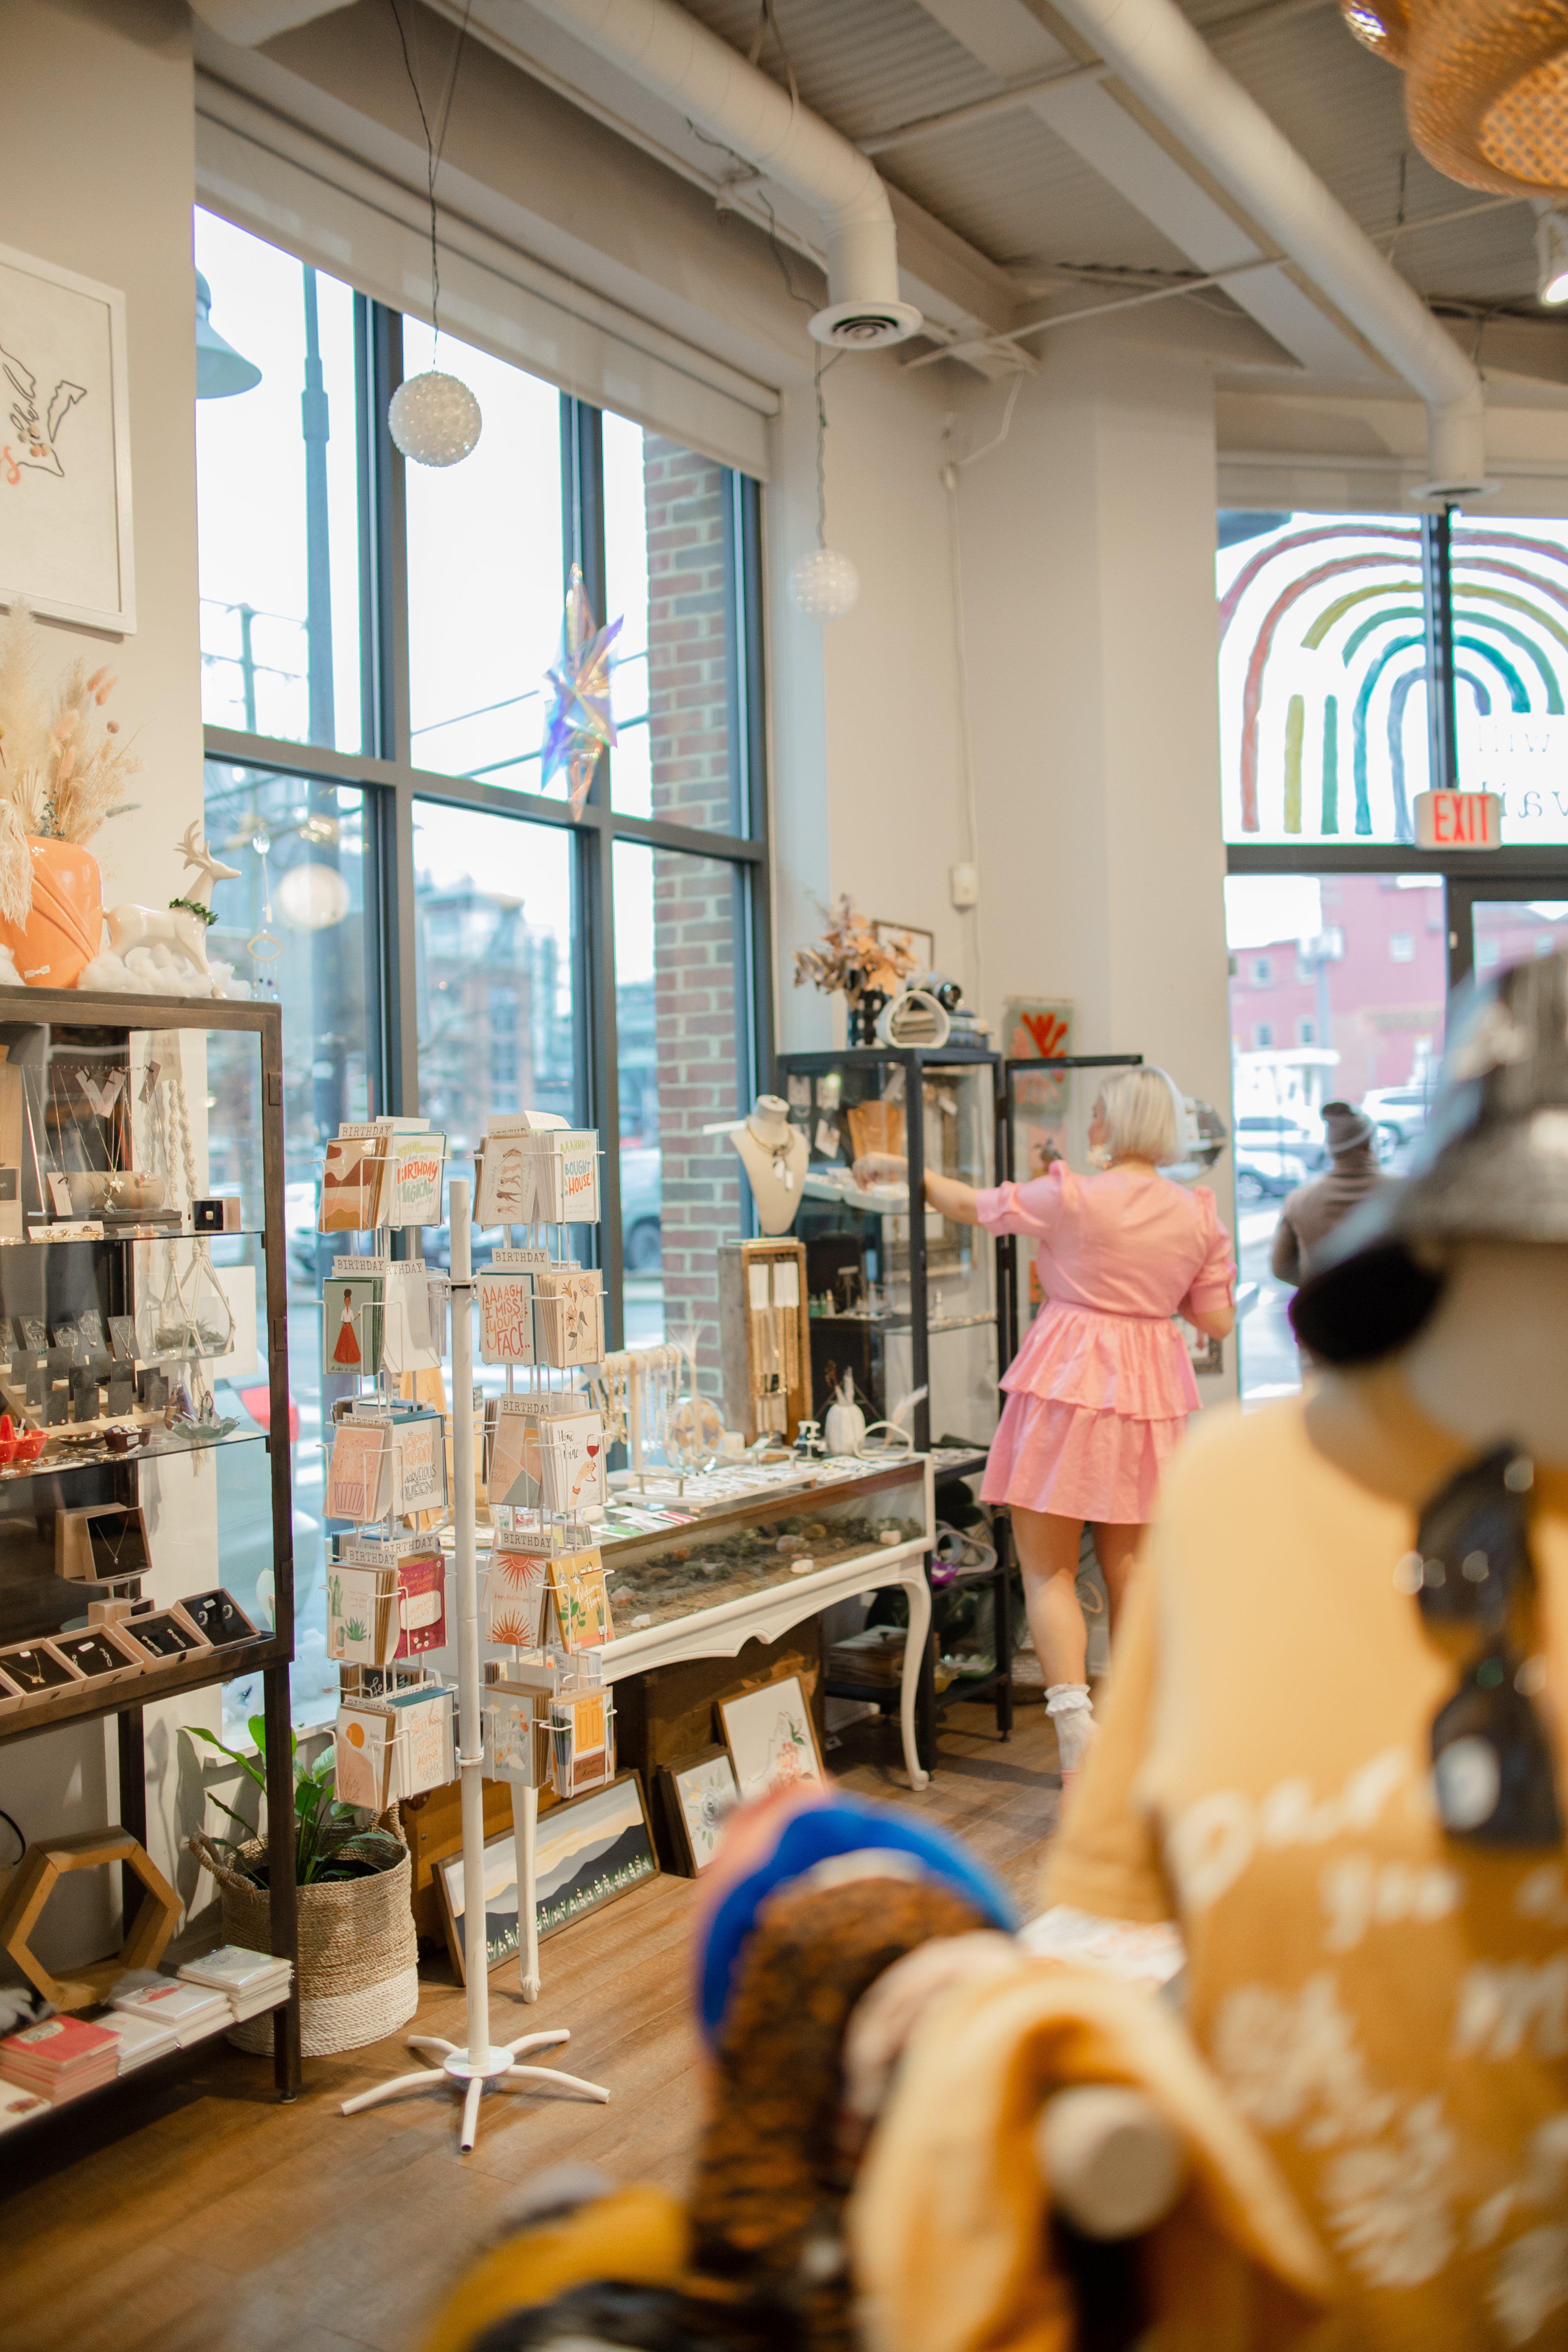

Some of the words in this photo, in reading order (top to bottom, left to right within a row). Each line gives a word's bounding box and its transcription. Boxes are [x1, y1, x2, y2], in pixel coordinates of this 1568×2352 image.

[1434, 795, 1490, 843] EXIT
[342, 1126, 391, 1137] BIRTHDAY
[397, 1161, 438, 1184] BIRTHDAY
[565, 1160, 591, 1176] BOUGHT
[397, 1178, 433, 1203] MAGICAL
[337, 1259, 384, 1271] BIRTHDAY
[495, 1252, 545, 1262] BIRTHDAY
[386, 1263, 423, 1275] RTHDAY
[482, 1284, 523, 1311] AAAAGH
[486, 1306, 492, 1319] I
[495, 1297, 520, 1318] MISS
[486, 1311, 519, 1350] your
[503, 1401, 551, 1414] BIRTHDAY
[396, 1431, 431, 1455] HAPPY
[557, 1430, 575, 1442] Home
[397, 1440, 435, 1467] BIRTHDAY
[400, 1480, 434, 1502] QUEEN
[384, 1537, 433, 1552] BIRTHDAY
[503, 1533, 551, 1548] BIRTHDAY
[349, 1550, 395, 1565] BIRTHDAY
[575, 1582, 601, 1603] Welcome
[494, 1718, 521, 1738] Hello
[417, 1725, 441, 1752] SMART
[417, 1749, 438, 1771] AGING
[423, 1761, 442, 1781] GRACE
